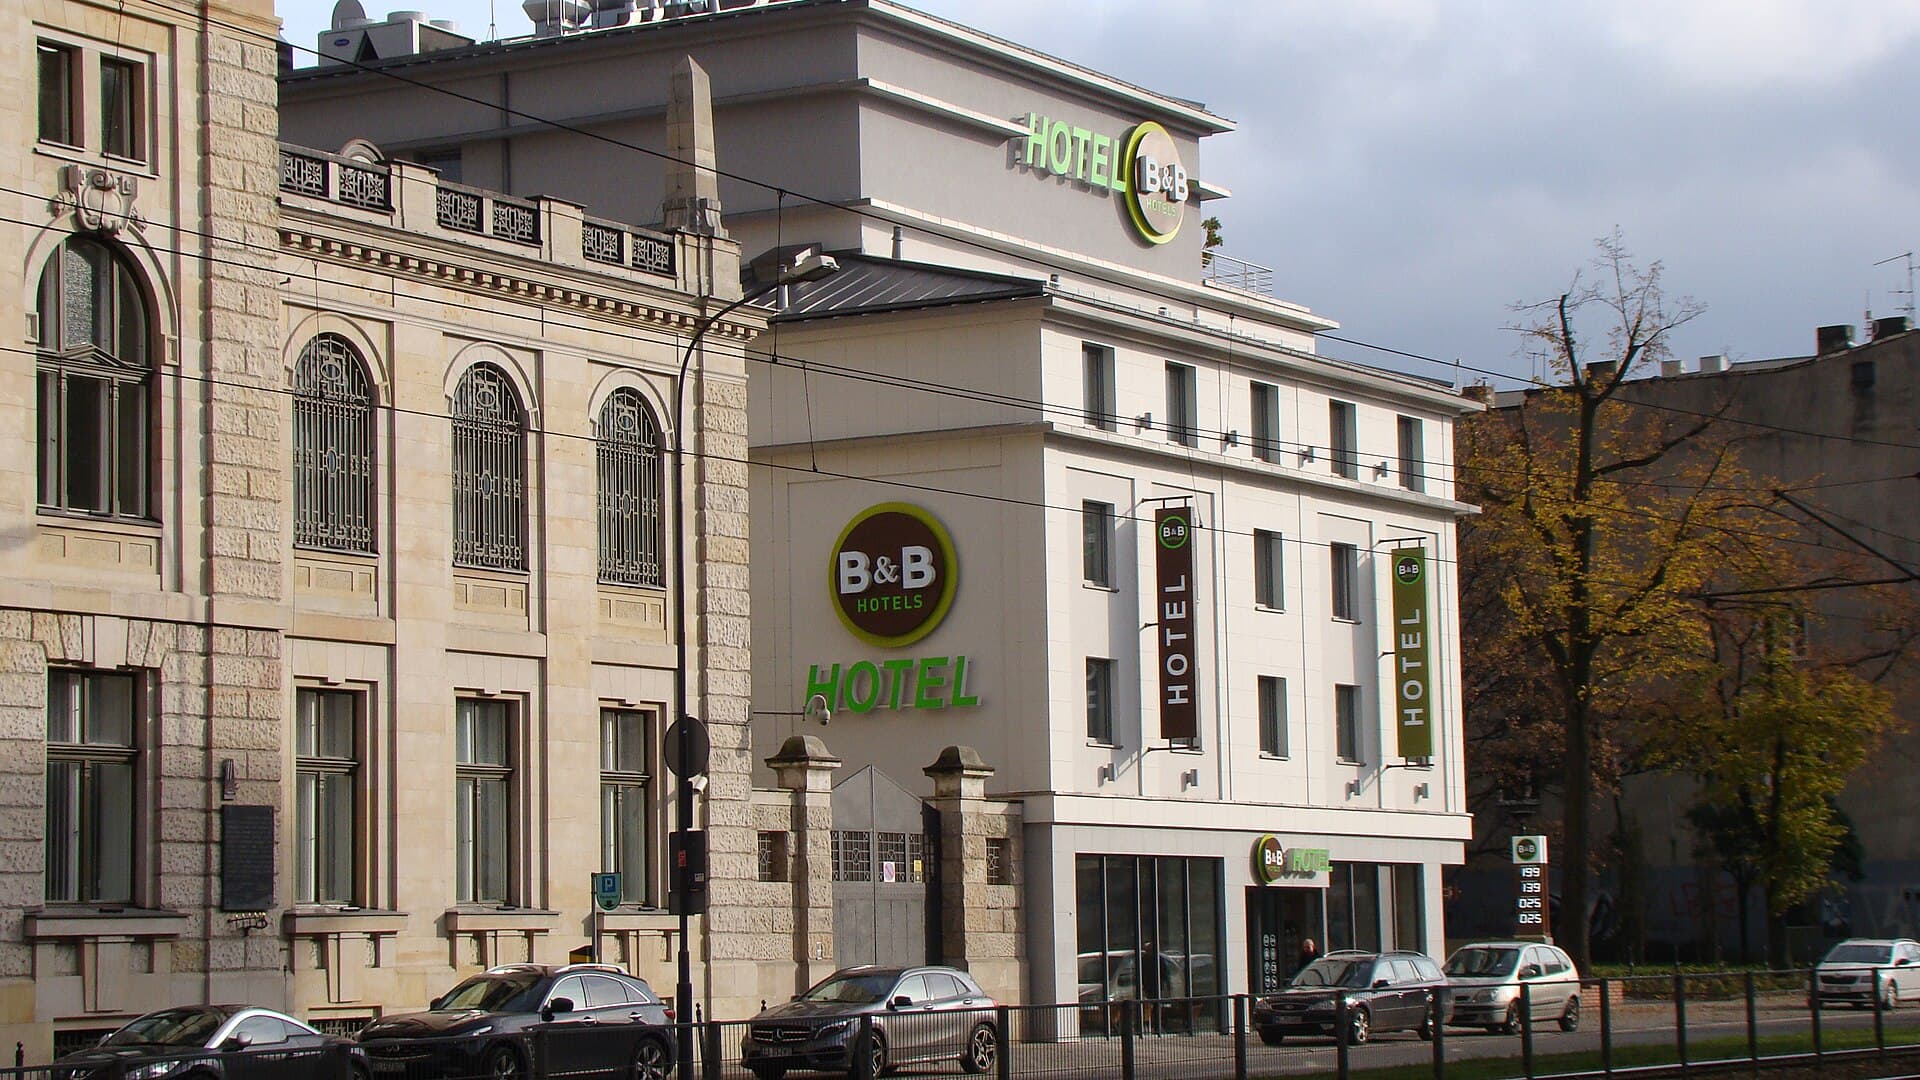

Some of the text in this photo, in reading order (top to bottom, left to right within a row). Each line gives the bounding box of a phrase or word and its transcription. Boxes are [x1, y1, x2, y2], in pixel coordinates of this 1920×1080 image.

[1027, 112, 1126, 192] HOTEL
[1137, 155, 1188, 202] B&B
[1146, 198, 1178, 216] HOTELS
[1163, 525, 1185, 537] B&B
[840, 545, 936, 594] B&B
[1398, 564, 1419, 575] B&B
[857, 594, 923, 613] HOTELS
[1165, 574, 1188, 705] HOTEL
[1400, 608, 1424, 727] HOTEL
[805, 655, 980, 715] HOTEL
[1265, 849, 1283, 866] B&B
[1292, 848, 1333, 872] HOTEL
[1521, 867, 1540, 877] 199
[1522, 883, 1541, 893] 139
